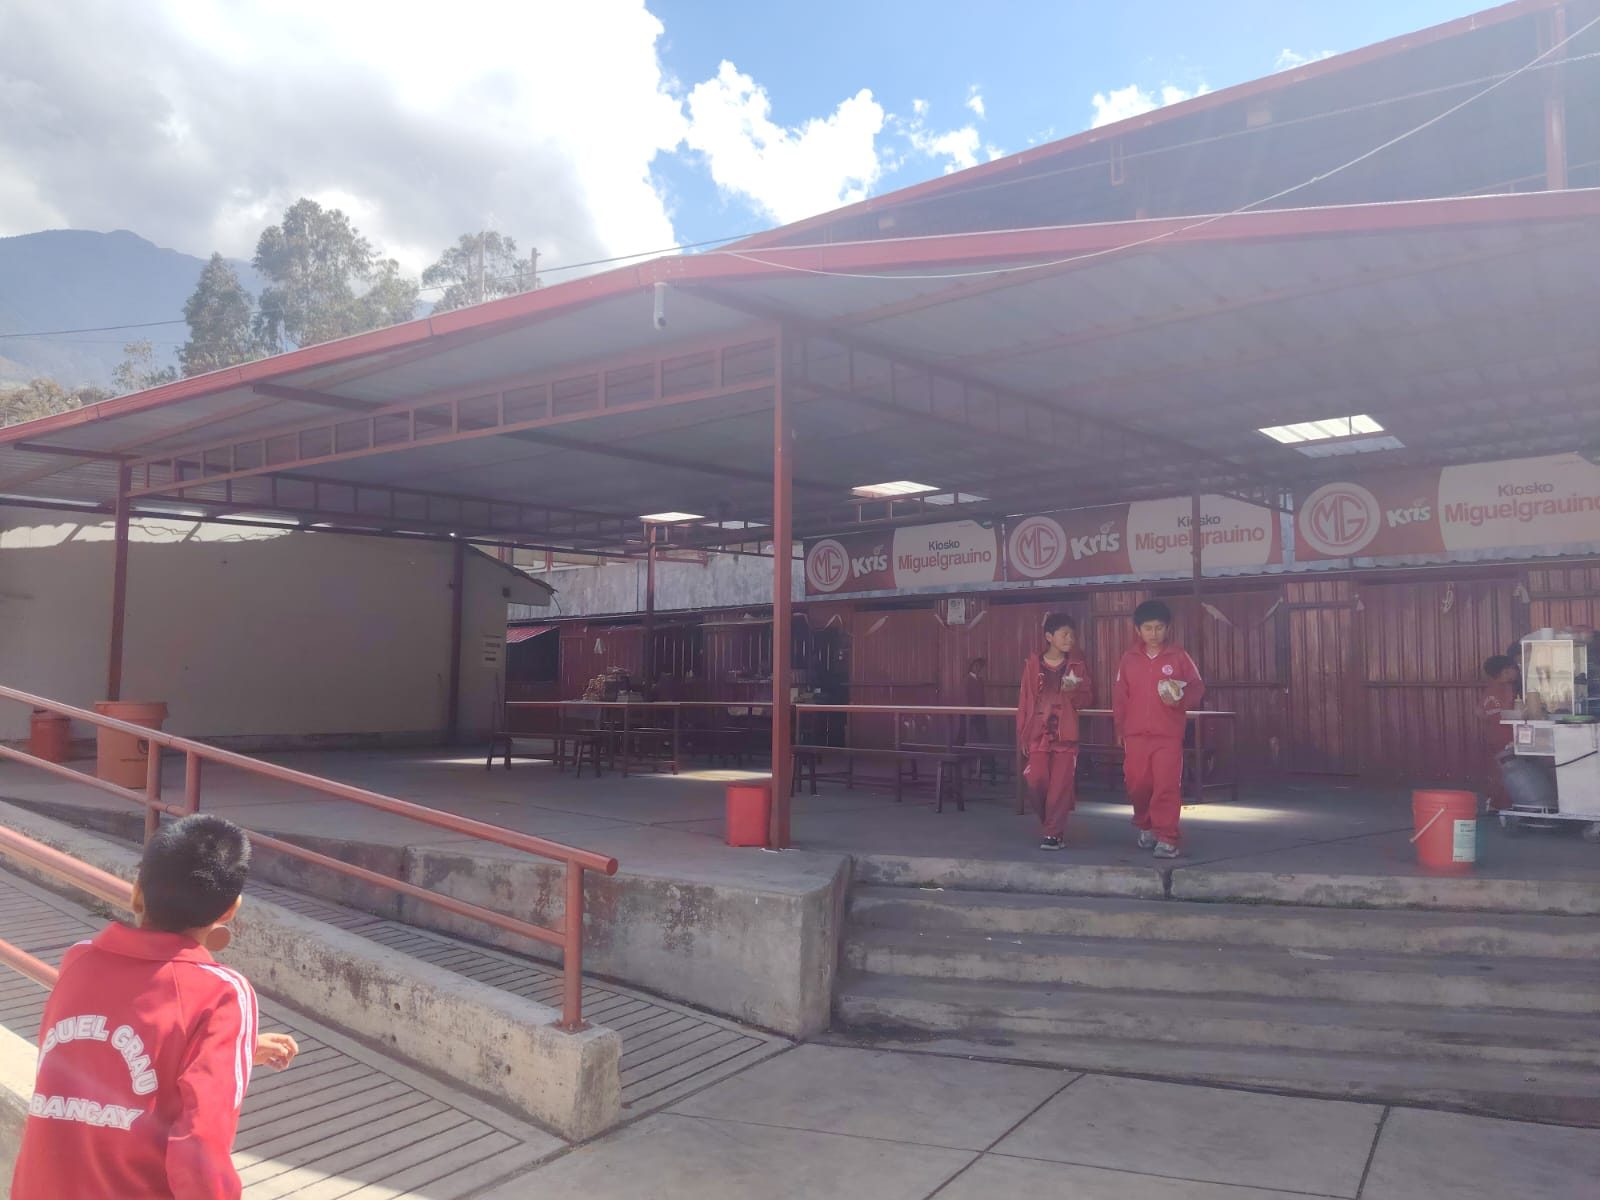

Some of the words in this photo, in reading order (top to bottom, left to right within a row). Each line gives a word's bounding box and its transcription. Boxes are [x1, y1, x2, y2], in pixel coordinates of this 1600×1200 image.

[1497, 482, 1554, 497] Kiosko
[1177, 514, 1221, 528] Kisko
[1386, 505, 1431, 528] Kris
[928, 539, 960, 551] Kiosko
[1070, 532, 1120, 561] Kris
[852, 553, 888, 578] Kris
[898, 547, 992, 574] Miguelgrauino
[111, 1024, 158, 1095] GRAU
[29, 1093, 144, 1130] BANCAY
